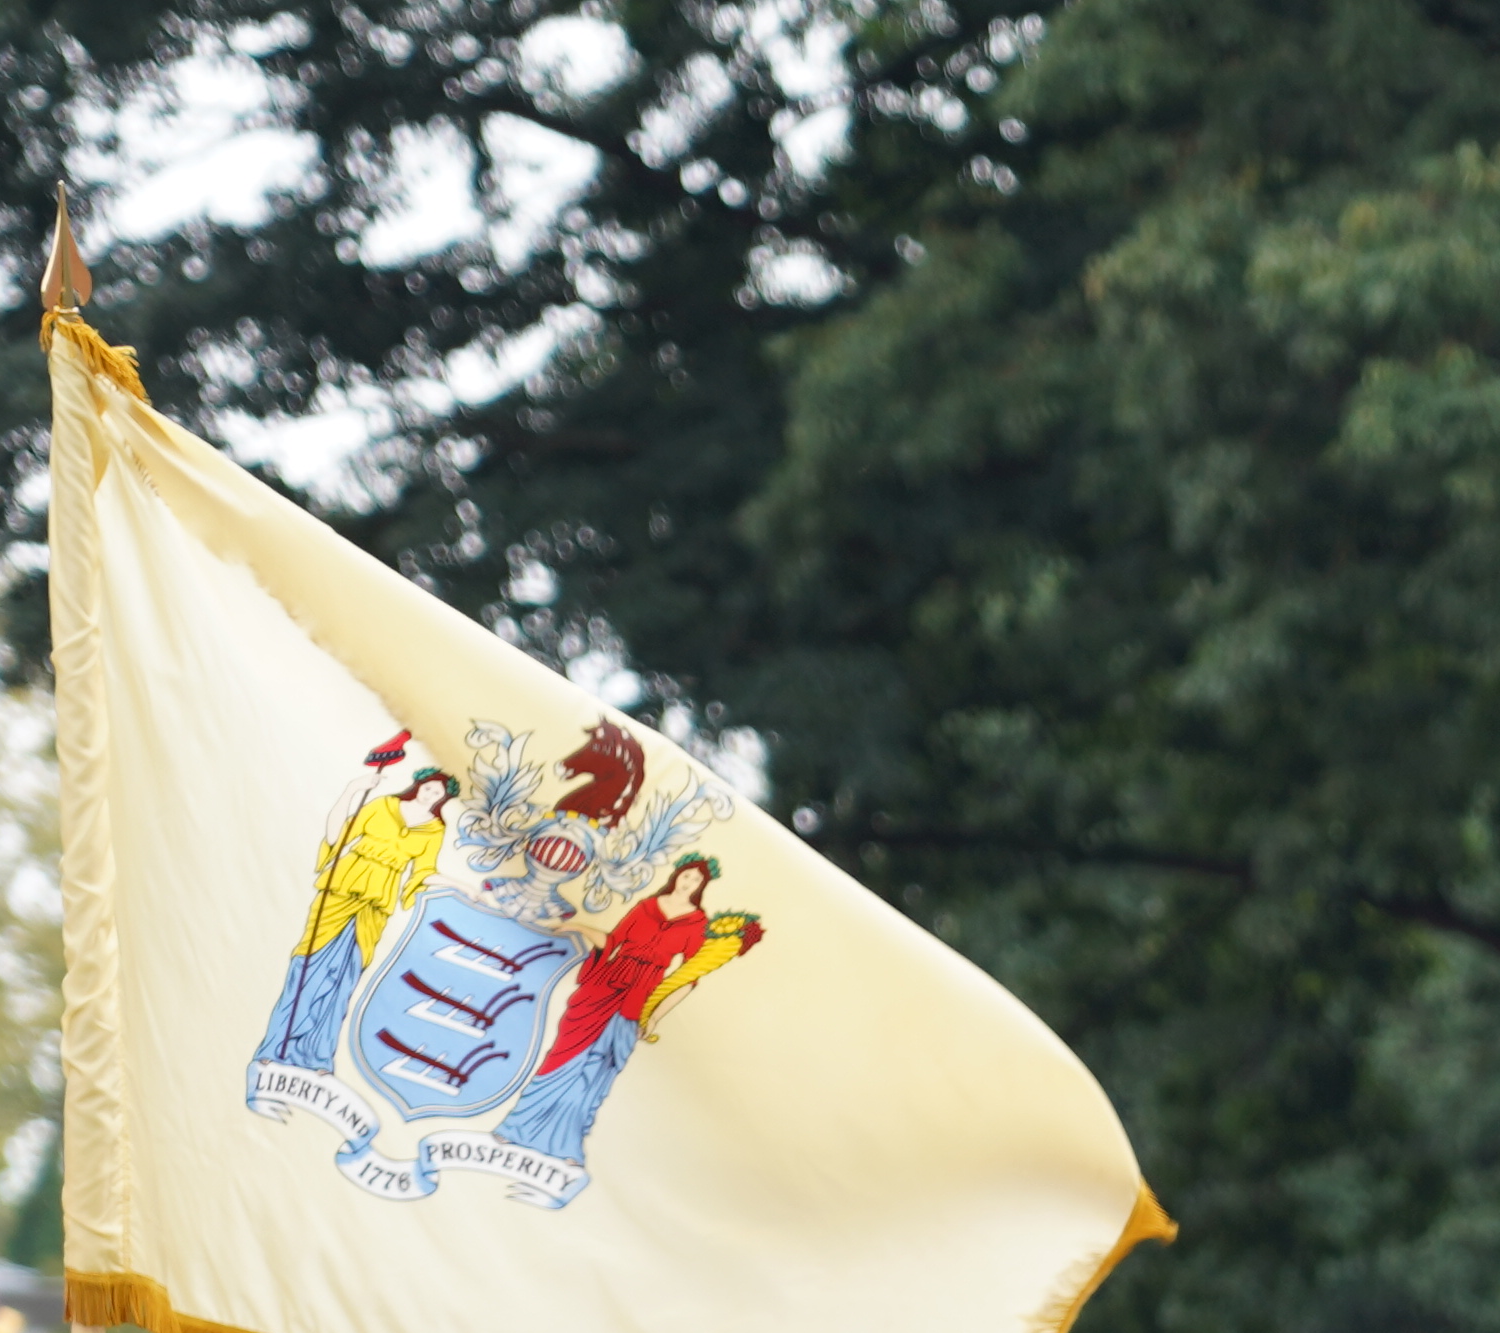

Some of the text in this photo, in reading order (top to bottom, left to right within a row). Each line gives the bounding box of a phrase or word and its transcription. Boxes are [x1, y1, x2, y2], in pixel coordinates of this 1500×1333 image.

[255, 1072, 578, 1192] LIBERTY AND PROSPERITY
[357, 1161, 412, 1192] 1776
